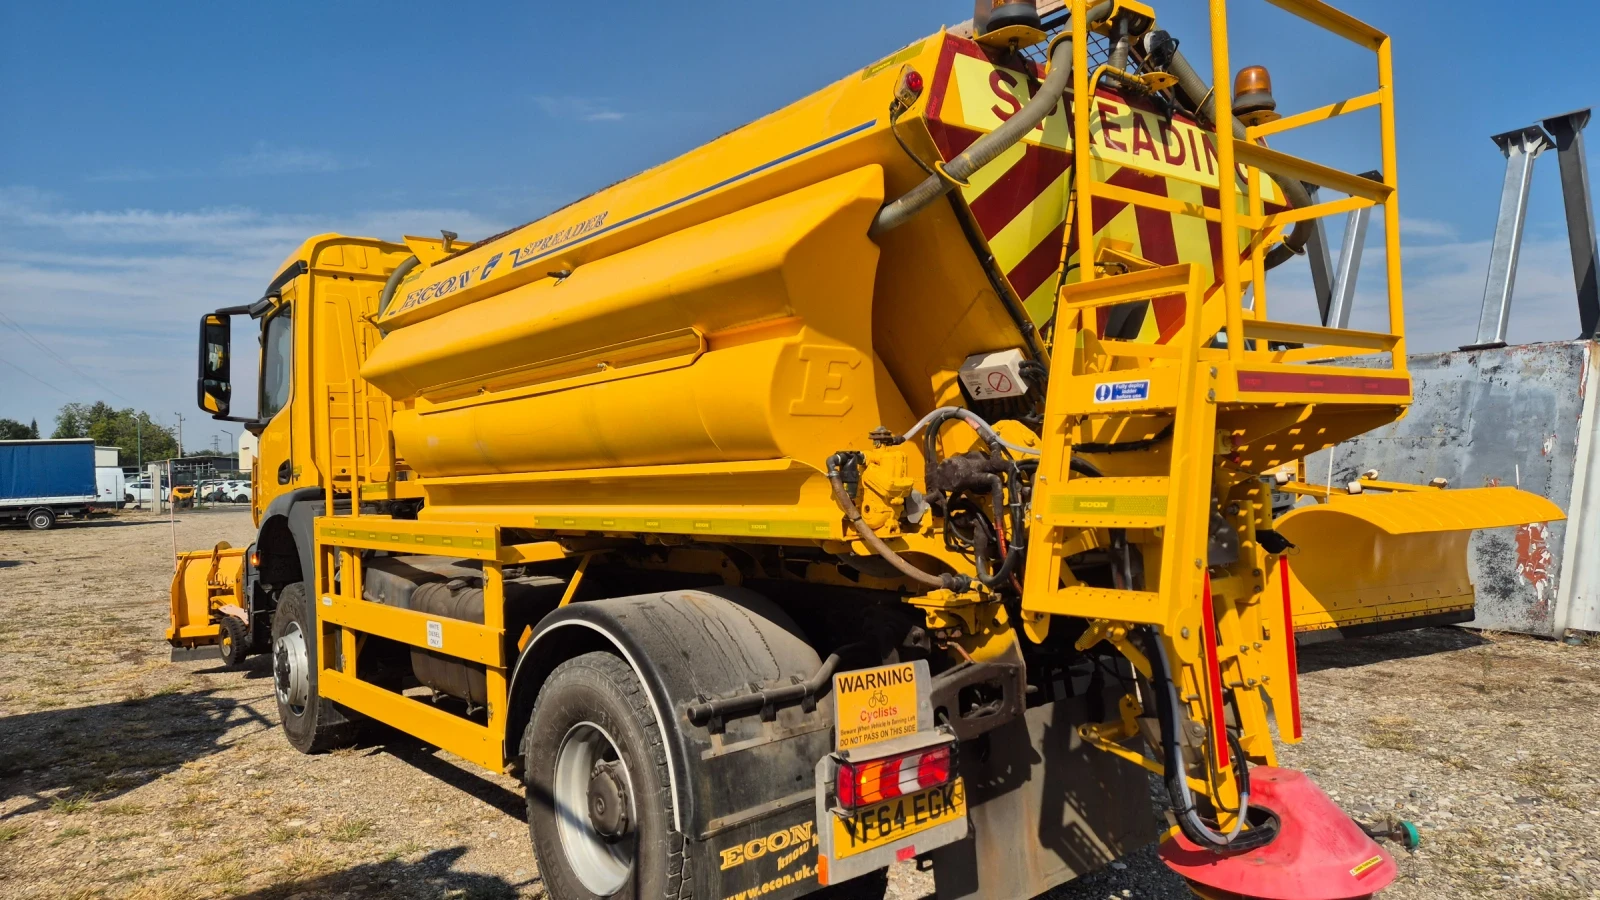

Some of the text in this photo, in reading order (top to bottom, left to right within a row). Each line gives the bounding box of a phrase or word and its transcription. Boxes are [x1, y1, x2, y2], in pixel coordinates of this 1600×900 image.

[520, 211, 608, 259] SPREADER
[790, 345, 861, 417] E
[838, 667, 914, 694] WARNING
[841, 728, 856, 736] Beware
[871, 721, 886, 729] Vehicle
[860, 706, 897, 723] Cyclists
[840, 724, 916, 746] DO NOT PASS ON THIS SIDE
[842, 783, 957, 848] YF64 EGK
[720, 821, 813, 870] ECON
[777, 842, 810, 871] know
